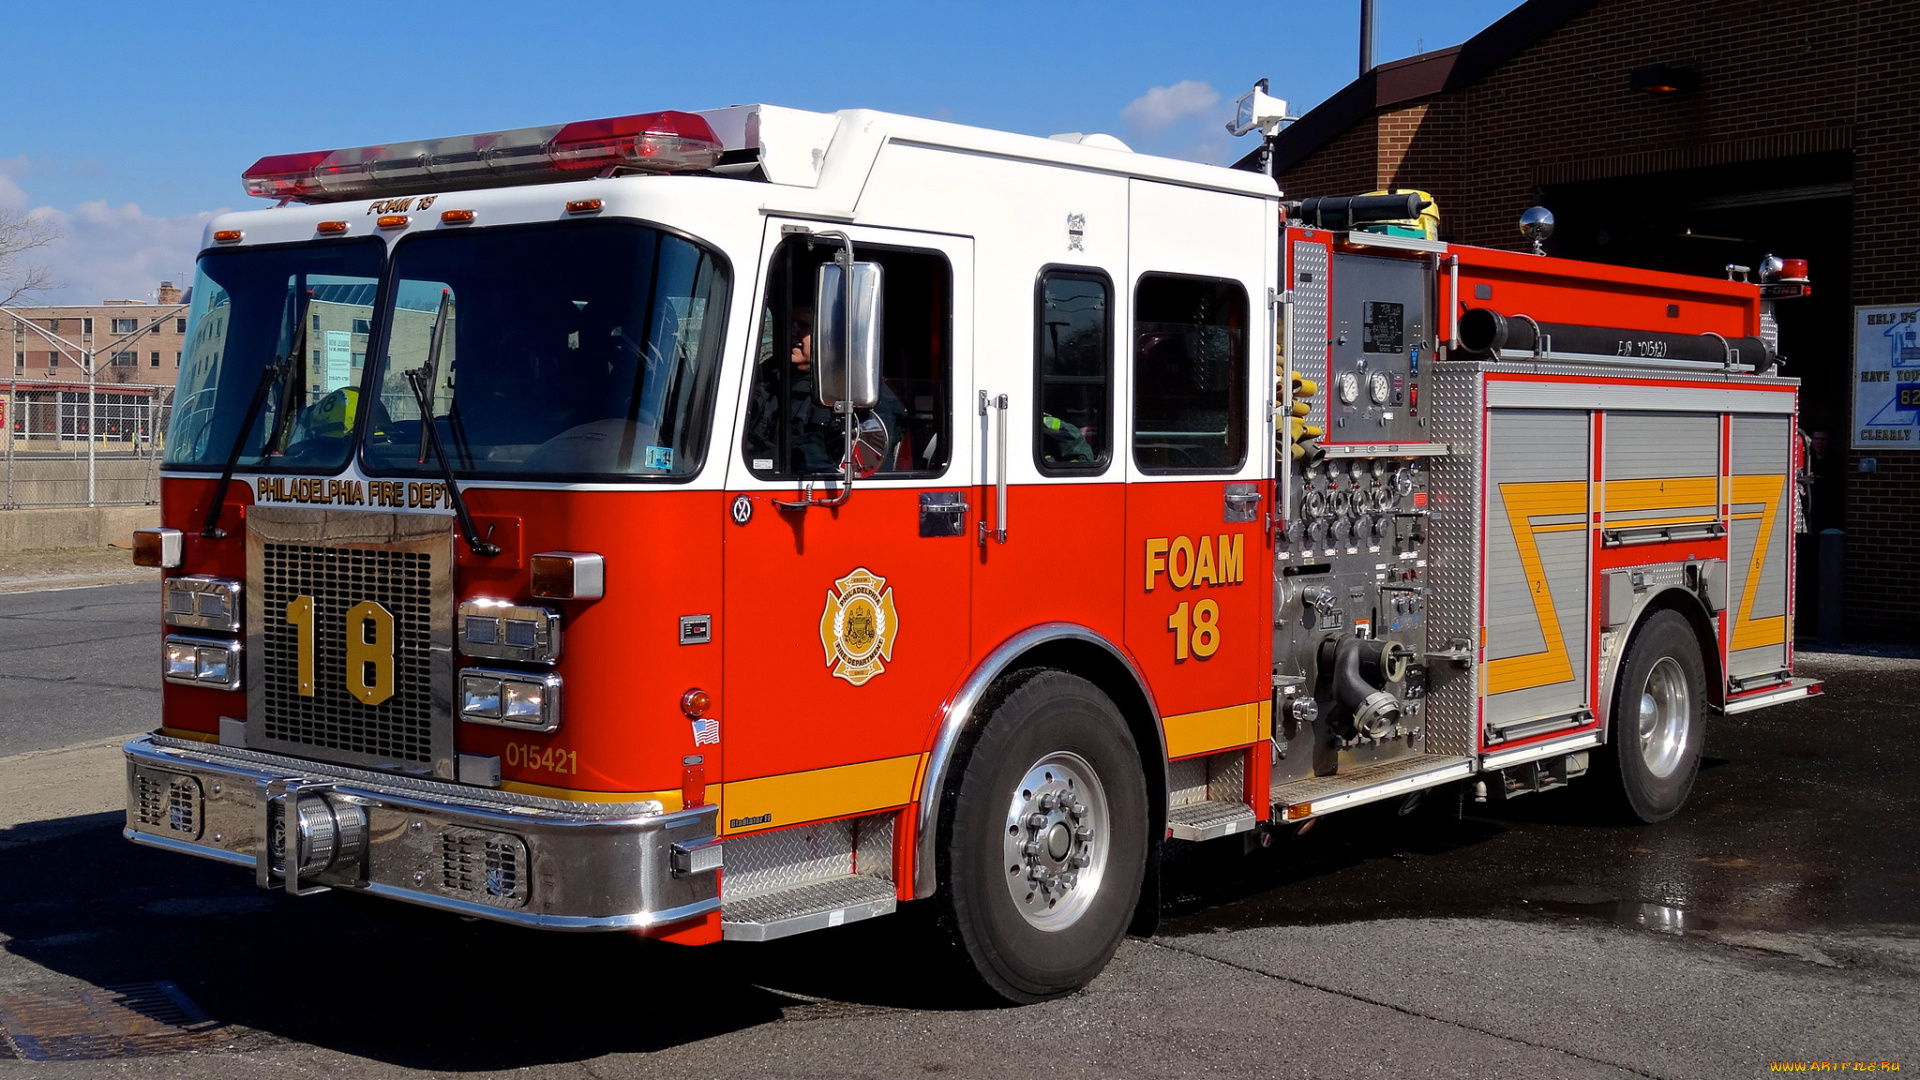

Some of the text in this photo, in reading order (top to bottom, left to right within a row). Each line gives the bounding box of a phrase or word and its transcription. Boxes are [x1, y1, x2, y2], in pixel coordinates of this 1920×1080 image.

[367, 195, 438, 215] FOAM 18
[1867, 312, 1917, 325] HELP US
[1861, 370, 1890, 383] HAVE
[1860, 429, 1912, 441] CLEARLY
[257, 477, 365, 505] PHILADELPHIA
[368, 481, 404, 507] FIRE
[1659, 481, 1664, 494] 4
[1144, 533, 1244, 594] FOAM
[1755, 557, 1760, 569] 6
[1536, 580, 1541, 593] 2
[840, 587, 882, 606] PHILADELPHIA
[1167, 598, 1221, 666] 18
[287, 594, 395, 706] 18
[835, 640, 884, 667] FIRE DEPARTMENT
[506, 741, 577, 775] 015421
